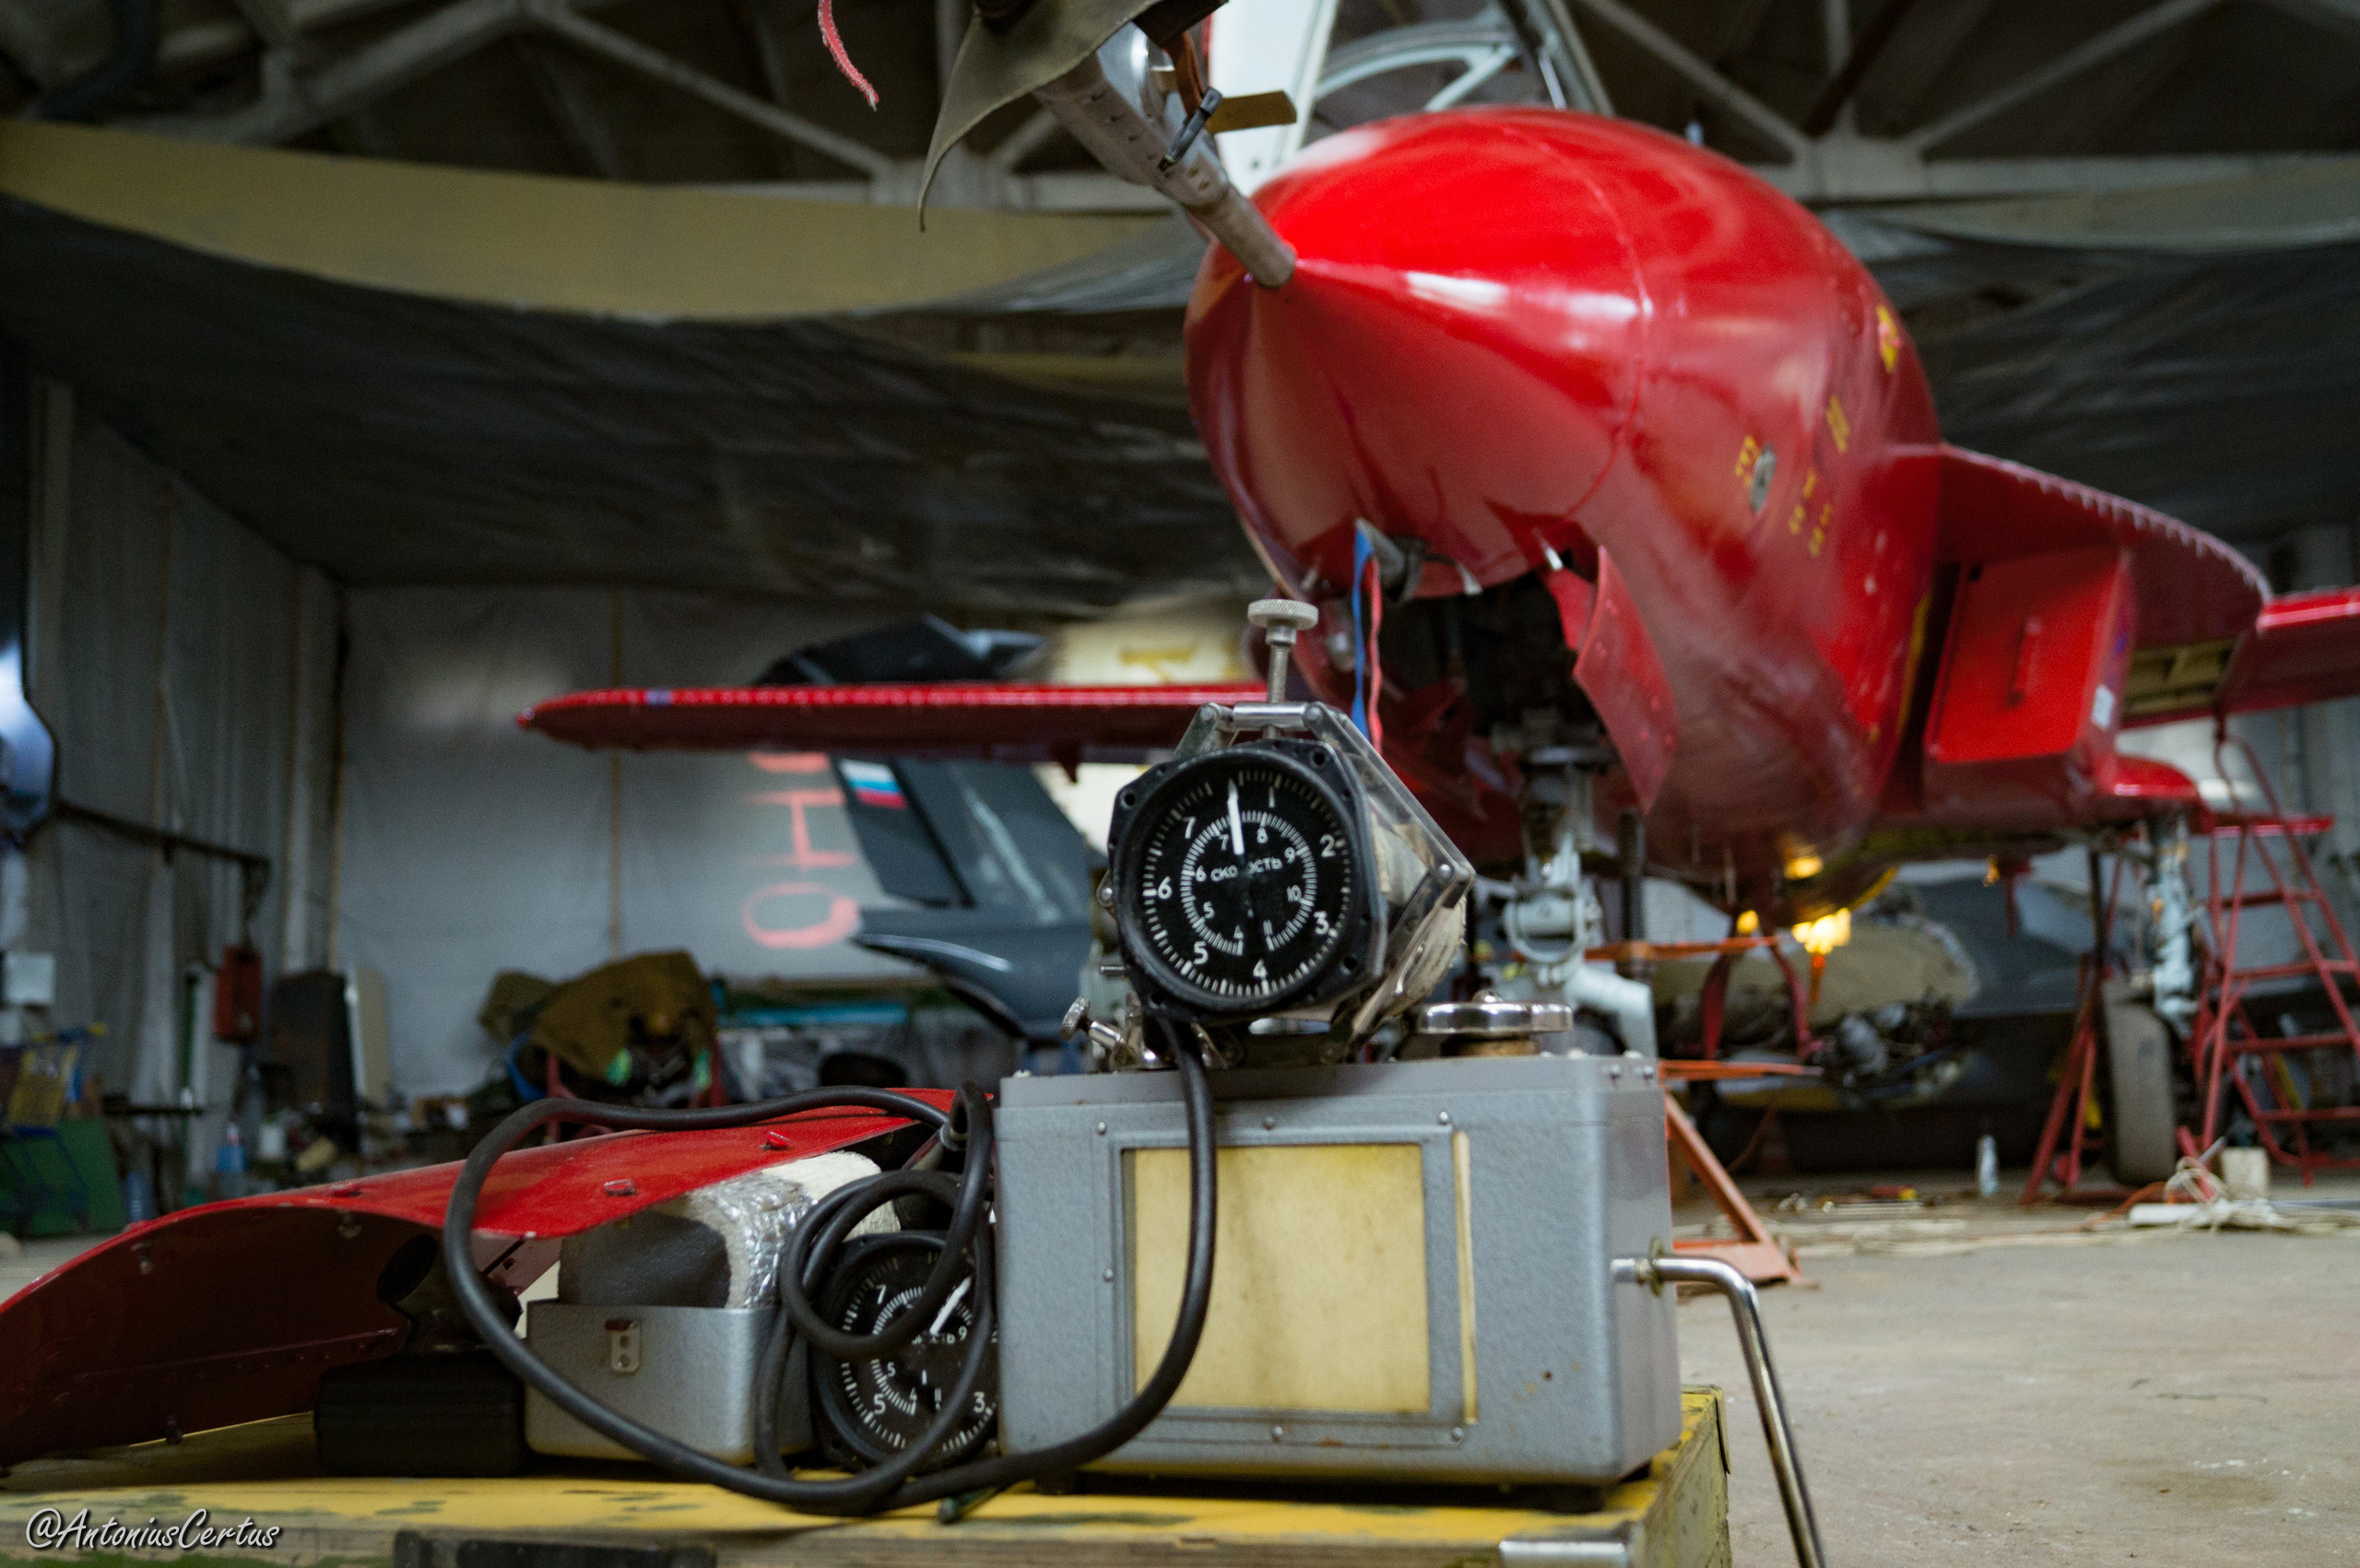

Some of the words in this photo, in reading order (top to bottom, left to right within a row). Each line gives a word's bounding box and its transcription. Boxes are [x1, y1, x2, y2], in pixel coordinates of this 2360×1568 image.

[1268, 785, 1275, 808] 1
[1184, 817, 1197, 839] 7
[1257, 827, 1268, 843] 8
[1219, 833, 1229, 851] 7
[1319, 834, 1336, 857] 2
[1284, 846, 1295, 864] 9
[1196, 865, 1207, 882] 6
[1158, 876, 1173, 900] 6
[1286, 885, 1301, 902] 10
[1203, 902, 1215, 918] 5
[1233, 924, 1244, 938] 4
[1313, 911, 1329, 935] 3
[1194, 941, 1209, 964] 5
[1253, 959, 1268, 979] 4
[876, 1284, 887, 1304] 7
[958, 1326, 967, 1341] 9
[887, 1362, 895, 1377] 5
[909, 1386, 918, 1400] 4
[974, 1391, 985, 1413] 3
[874, 1394, 886, 1415] 5
